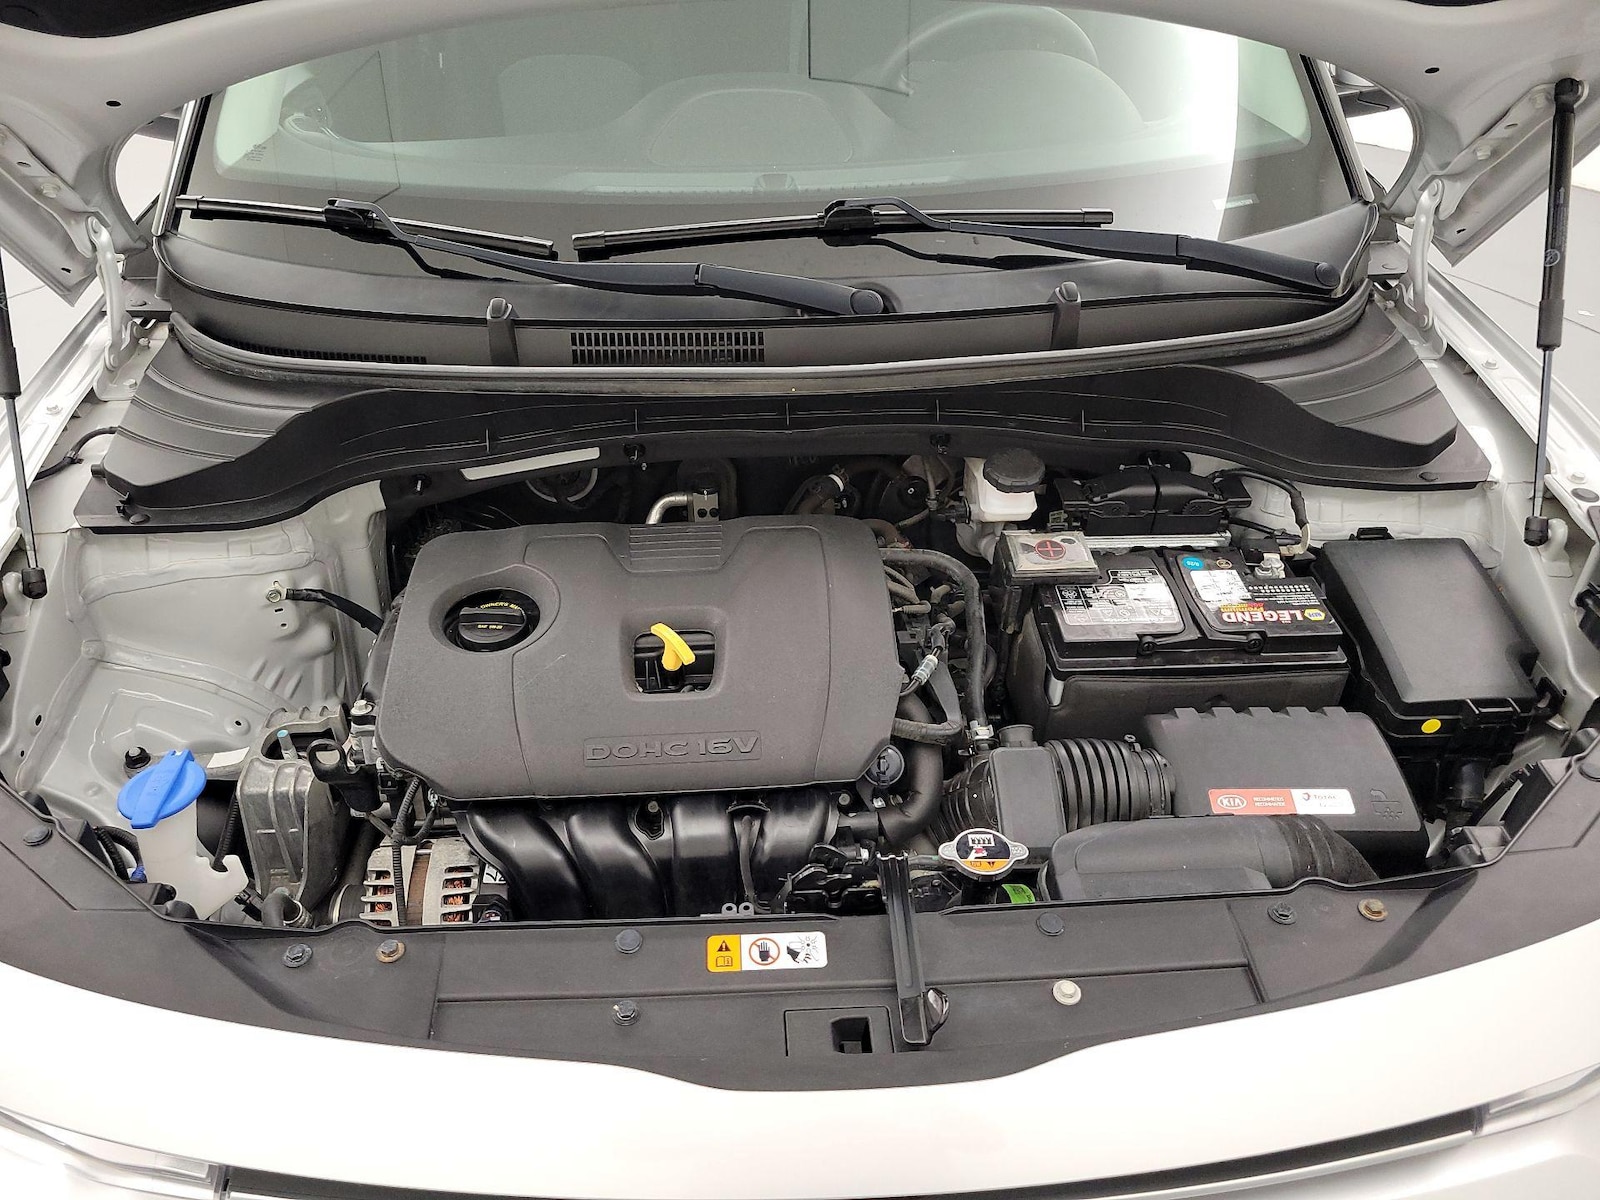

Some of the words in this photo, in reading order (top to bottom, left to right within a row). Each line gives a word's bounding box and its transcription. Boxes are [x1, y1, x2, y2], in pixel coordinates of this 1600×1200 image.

[1222, 609, 1304, 622] LEGEND
[586, 741, 689, 761] DOHC
[698, 736, 759, 756] 16V
[1221, 797, 1243, 809] KIA
